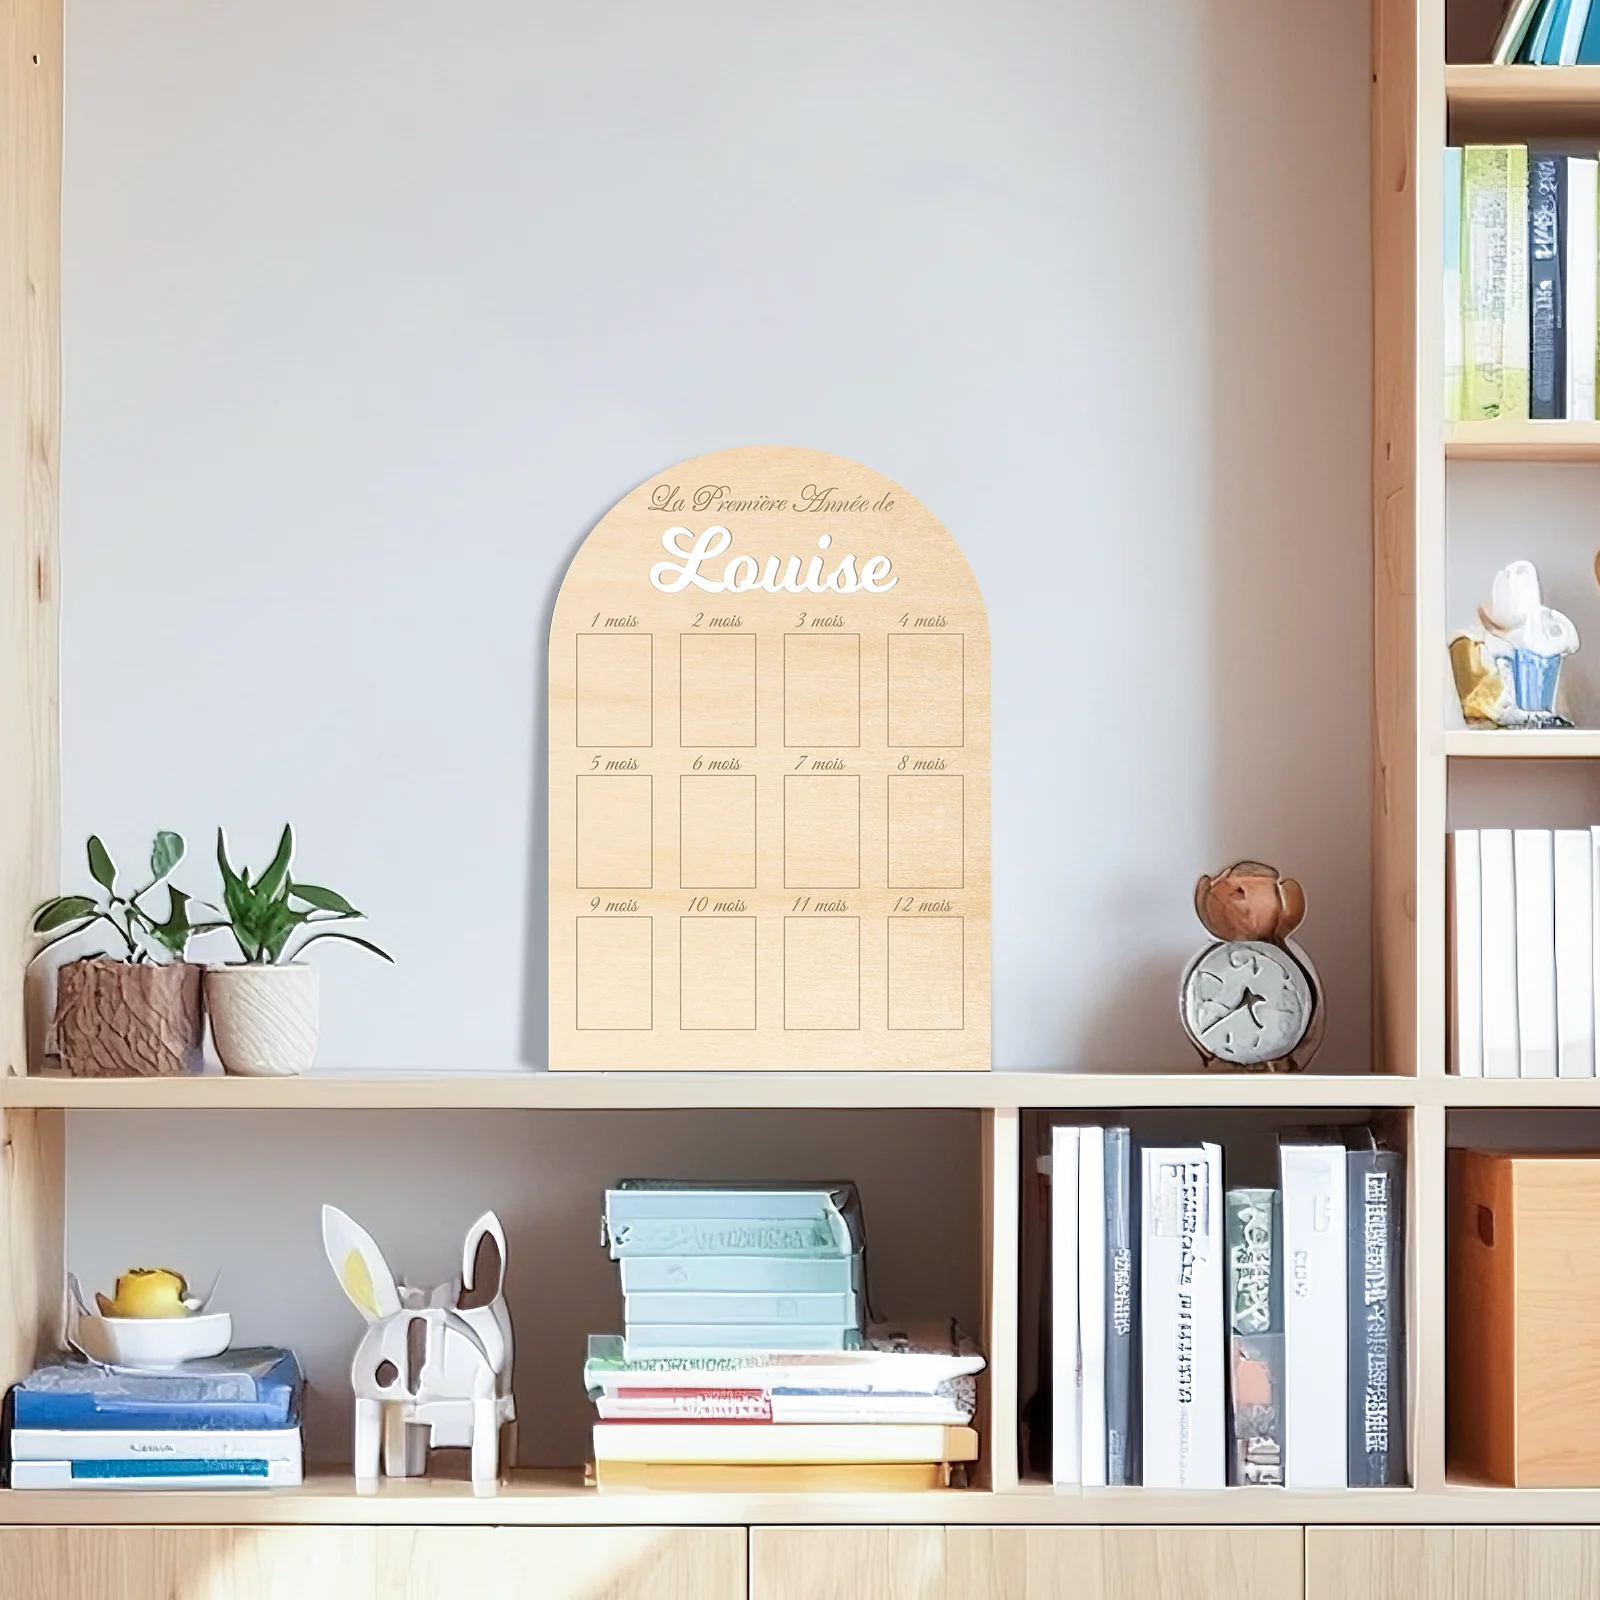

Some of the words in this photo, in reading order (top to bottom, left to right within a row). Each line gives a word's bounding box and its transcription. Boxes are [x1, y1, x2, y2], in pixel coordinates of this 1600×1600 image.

[647, 483, 686, 513] La
[691, 484, 789, 513] Première
[791, 483, 870, 513] Année
[871, 491, 895, 513] de
[649, 525, 899, 594] Louise
[590, 611, 602, 628] 1
[603, 614, 640, 628] mois
[690, 611, 705, 628] 2
[708, 614, 744, 628] mois
[794, 611, 808, 628] 3
[810, 614, 846, 628] mois
[898, 611, 910, 628] 4
[913, 614, 949, 628] mois
[588, 754, 603, 771] 5
[604, 757, 640, 771] mois
[692, 754, 704, 771] 6
[707, 757, 743, 771] mois
[793, 754, 809, 771] 7
[811, 757, 847, 771] mois
[896, 754, 910, 771] 8
[912, 757, 948, 771] mois
[590, 895, 601, 913] 9
[604, 899, 640, 913] mois
[687, 896, 710, 913] 10
[712, 899, 748, 913] mois
[791, 895, 812, 912] 11
[813, 899, 849, 913] mois
[892, 896, 915, 913] 12
[917, 899, 954, 913] mois
